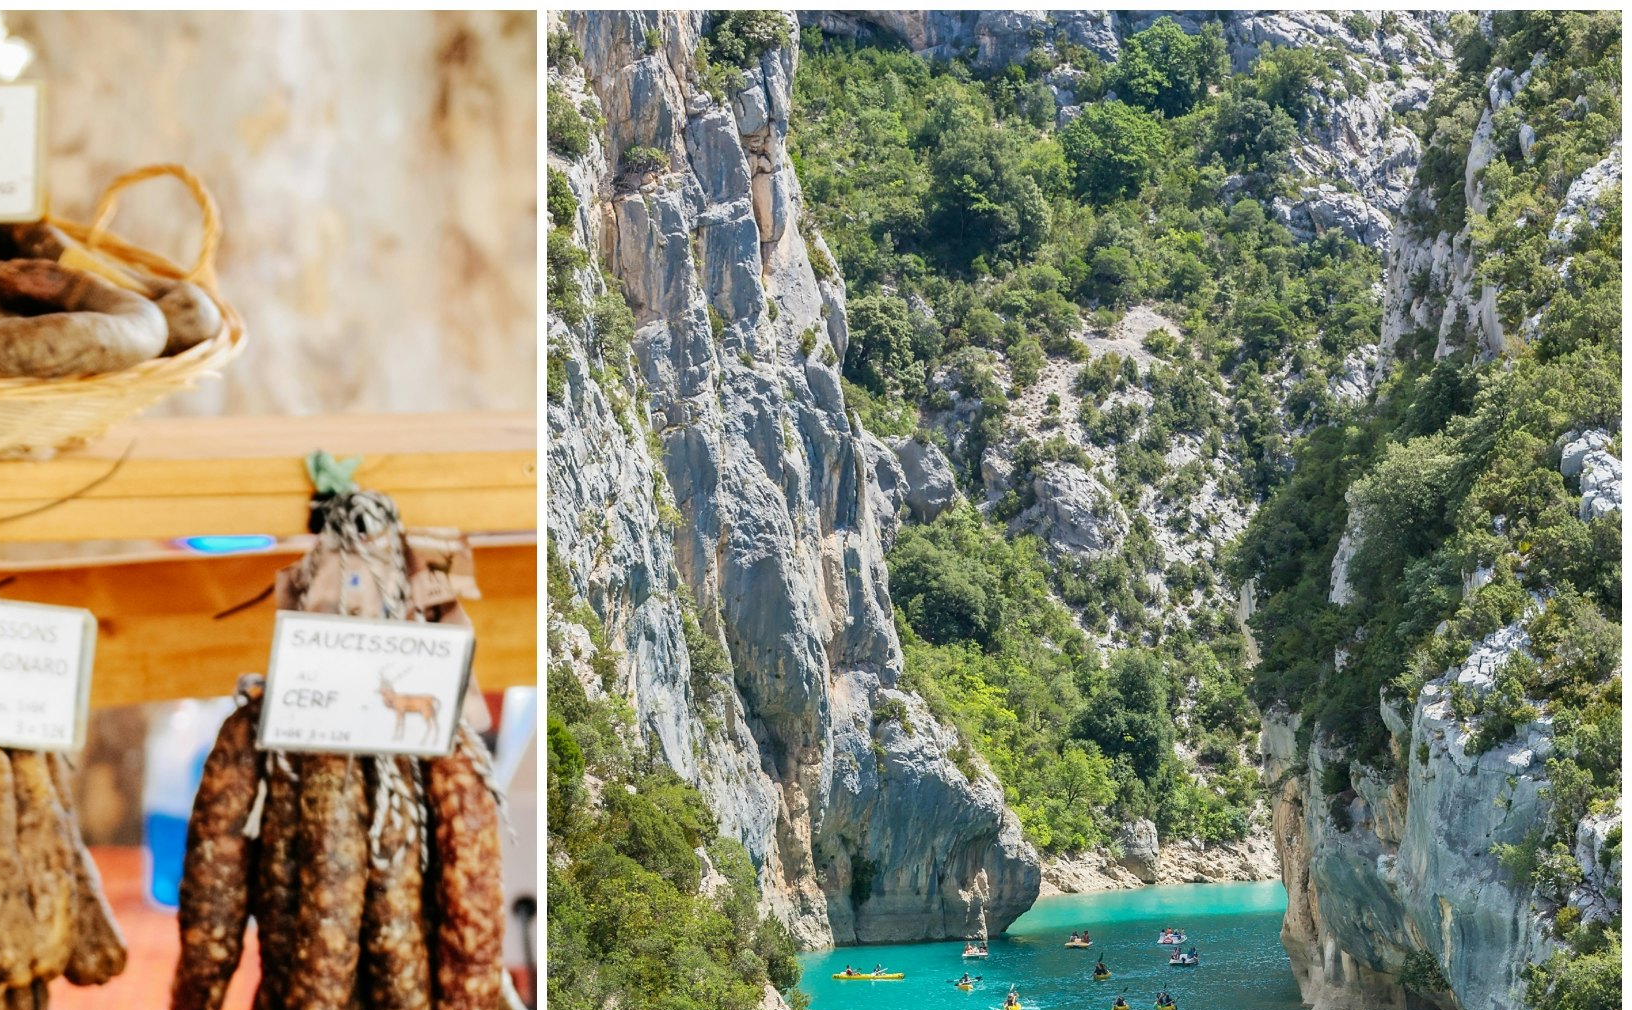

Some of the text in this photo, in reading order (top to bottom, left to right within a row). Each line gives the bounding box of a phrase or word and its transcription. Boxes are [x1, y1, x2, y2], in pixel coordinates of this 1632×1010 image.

[291, 629, 451, 658] SAUCISSONS
[296, 670, 317, 682] AU
[282, 688, 339, 709] CERF
